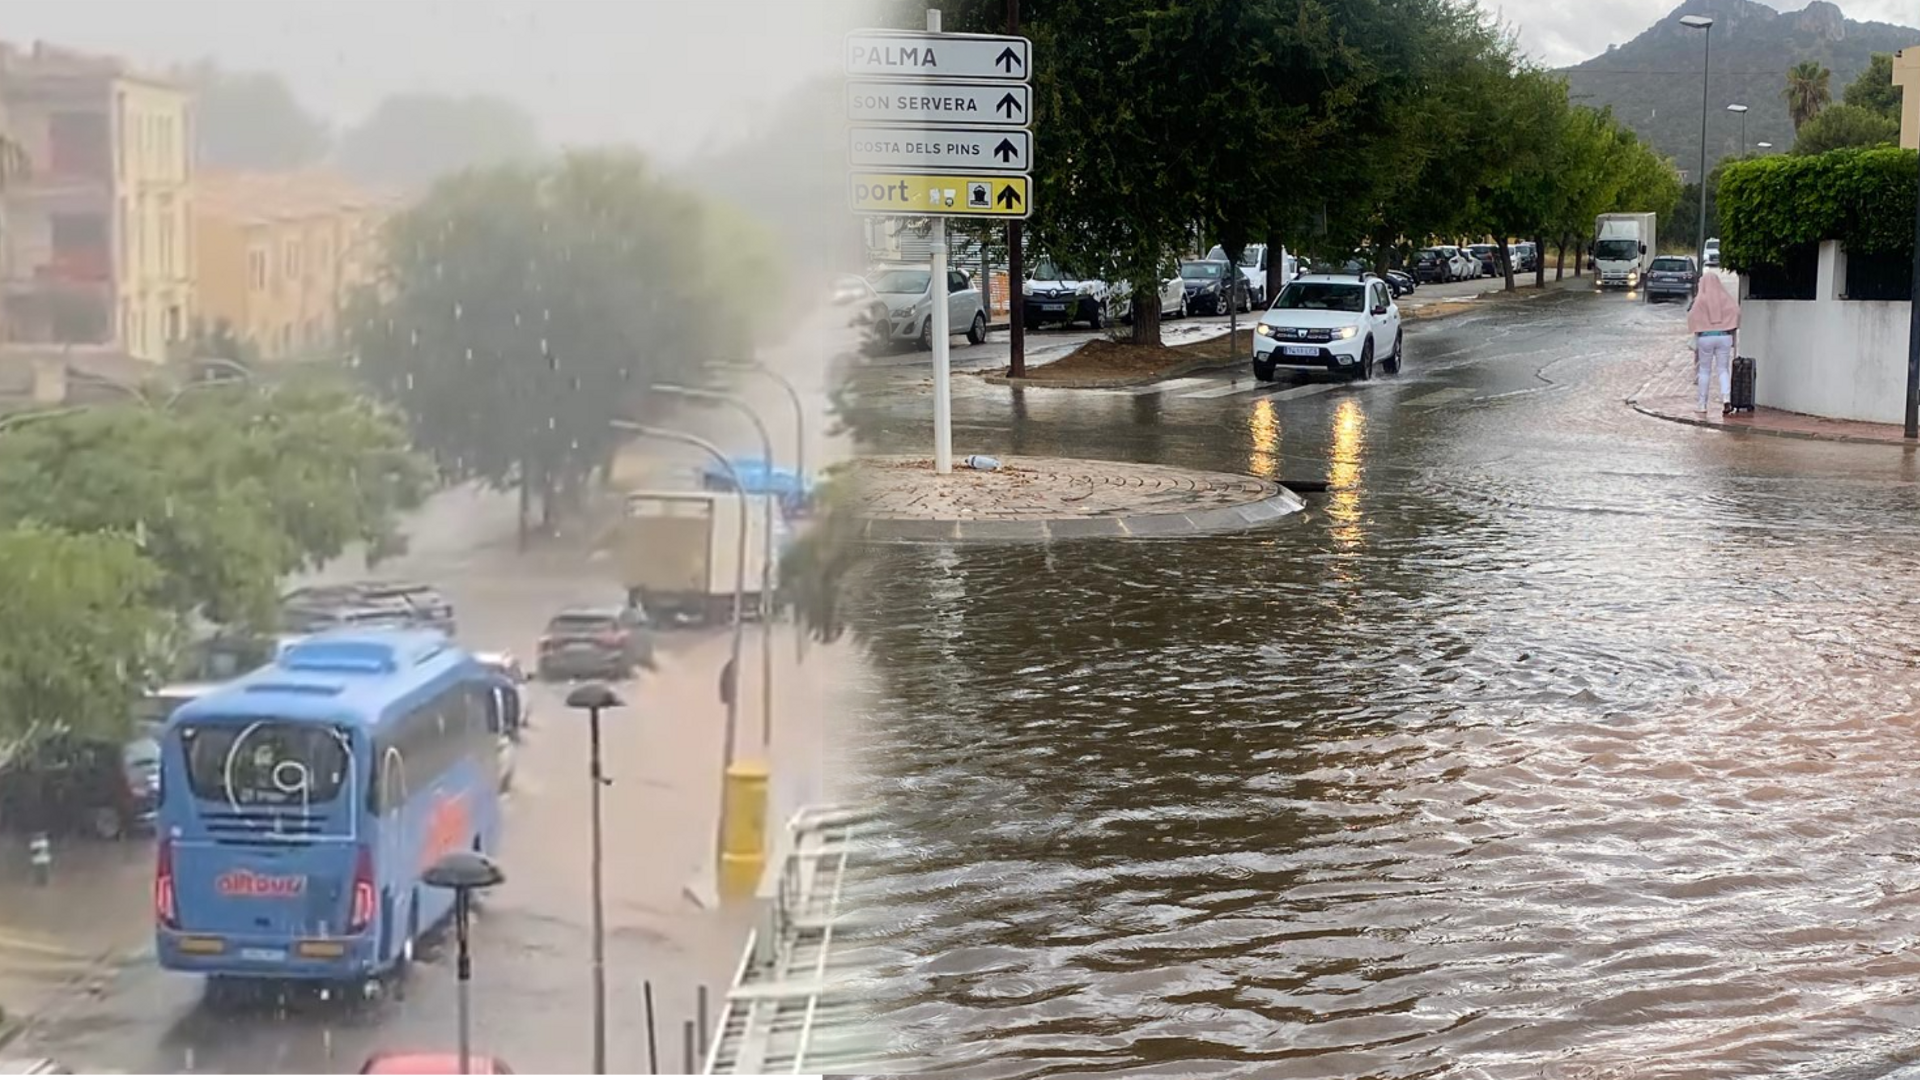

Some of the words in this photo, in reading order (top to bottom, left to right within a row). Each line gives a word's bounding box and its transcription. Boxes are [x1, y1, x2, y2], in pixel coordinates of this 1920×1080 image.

[852, 46, 937, 67] PALMA
[853, 96, 889, 109] SON
[897, 96, 977, 112] SERVERA
[854, 141, 900, 154] COSTA
[905, 142, 941, 155] DELS
[947, 143, 980, 155] PINS
[855, 180, 909, 203] port
